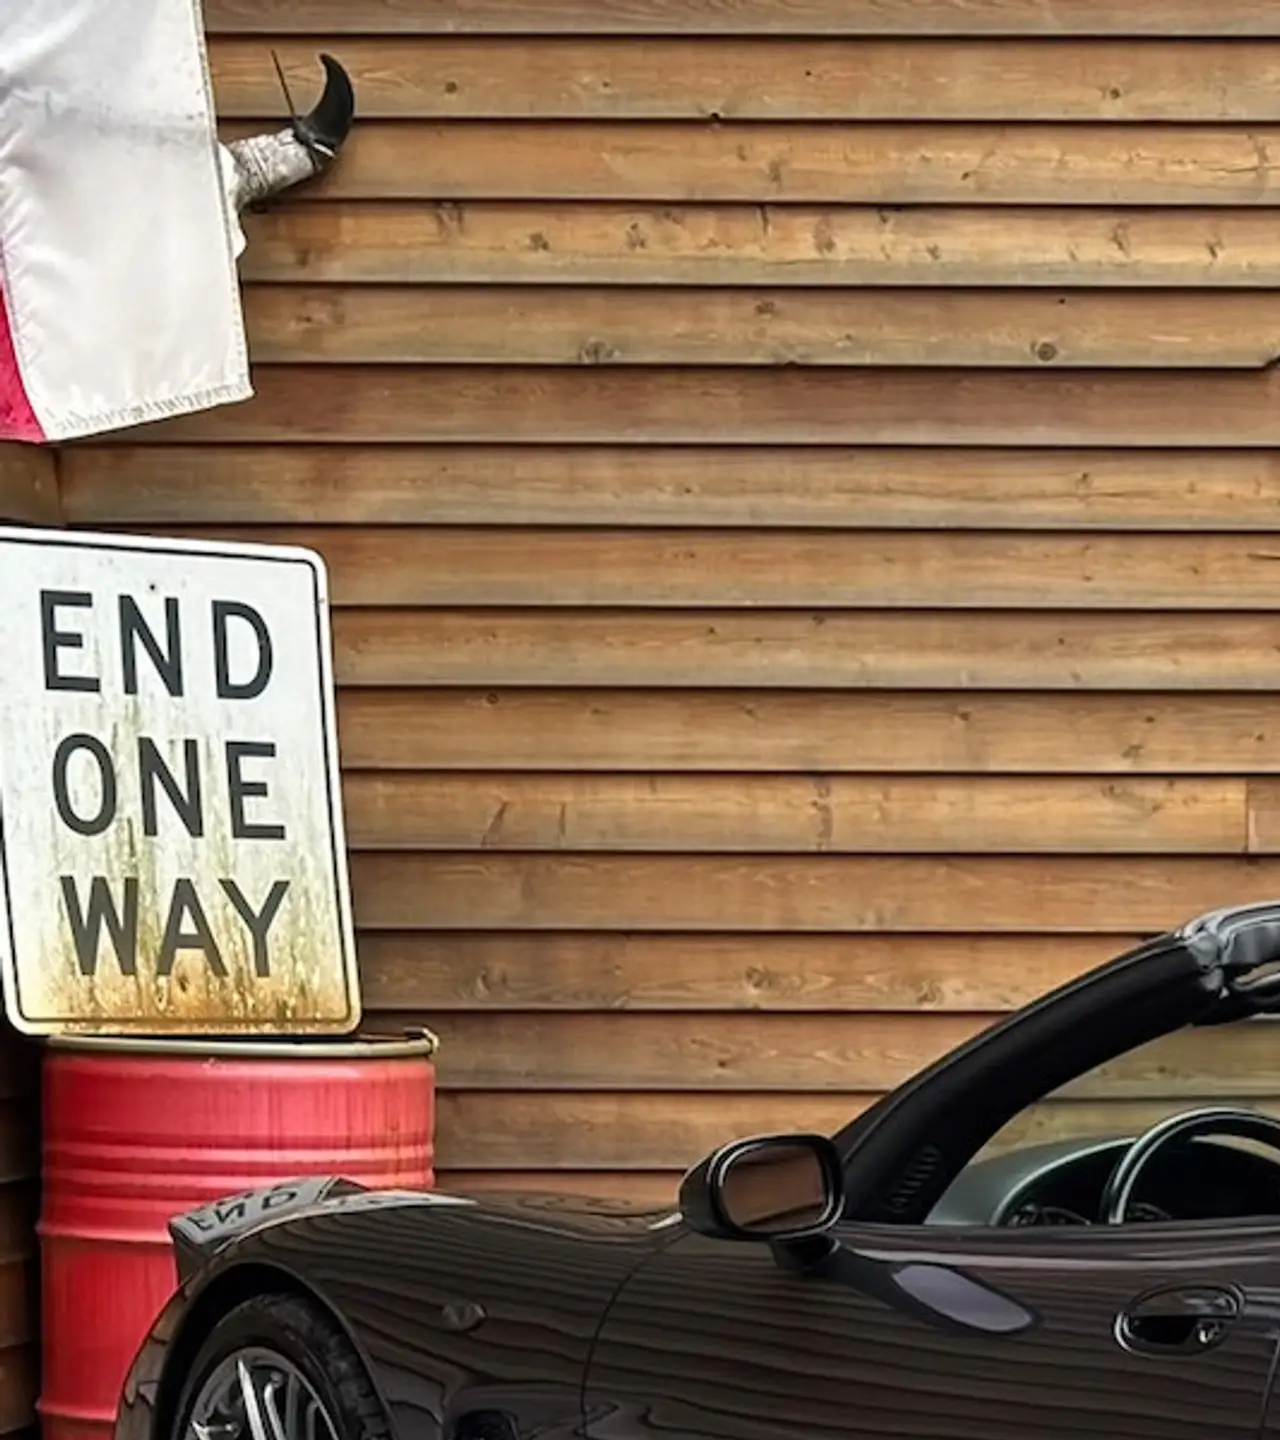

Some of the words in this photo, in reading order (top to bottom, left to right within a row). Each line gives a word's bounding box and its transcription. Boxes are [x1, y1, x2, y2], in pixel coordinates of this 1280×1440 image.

[40, 589, 274, 699] END
[52, 733, 287, 841] ONE
[60, 875, 291, 978] WAY
